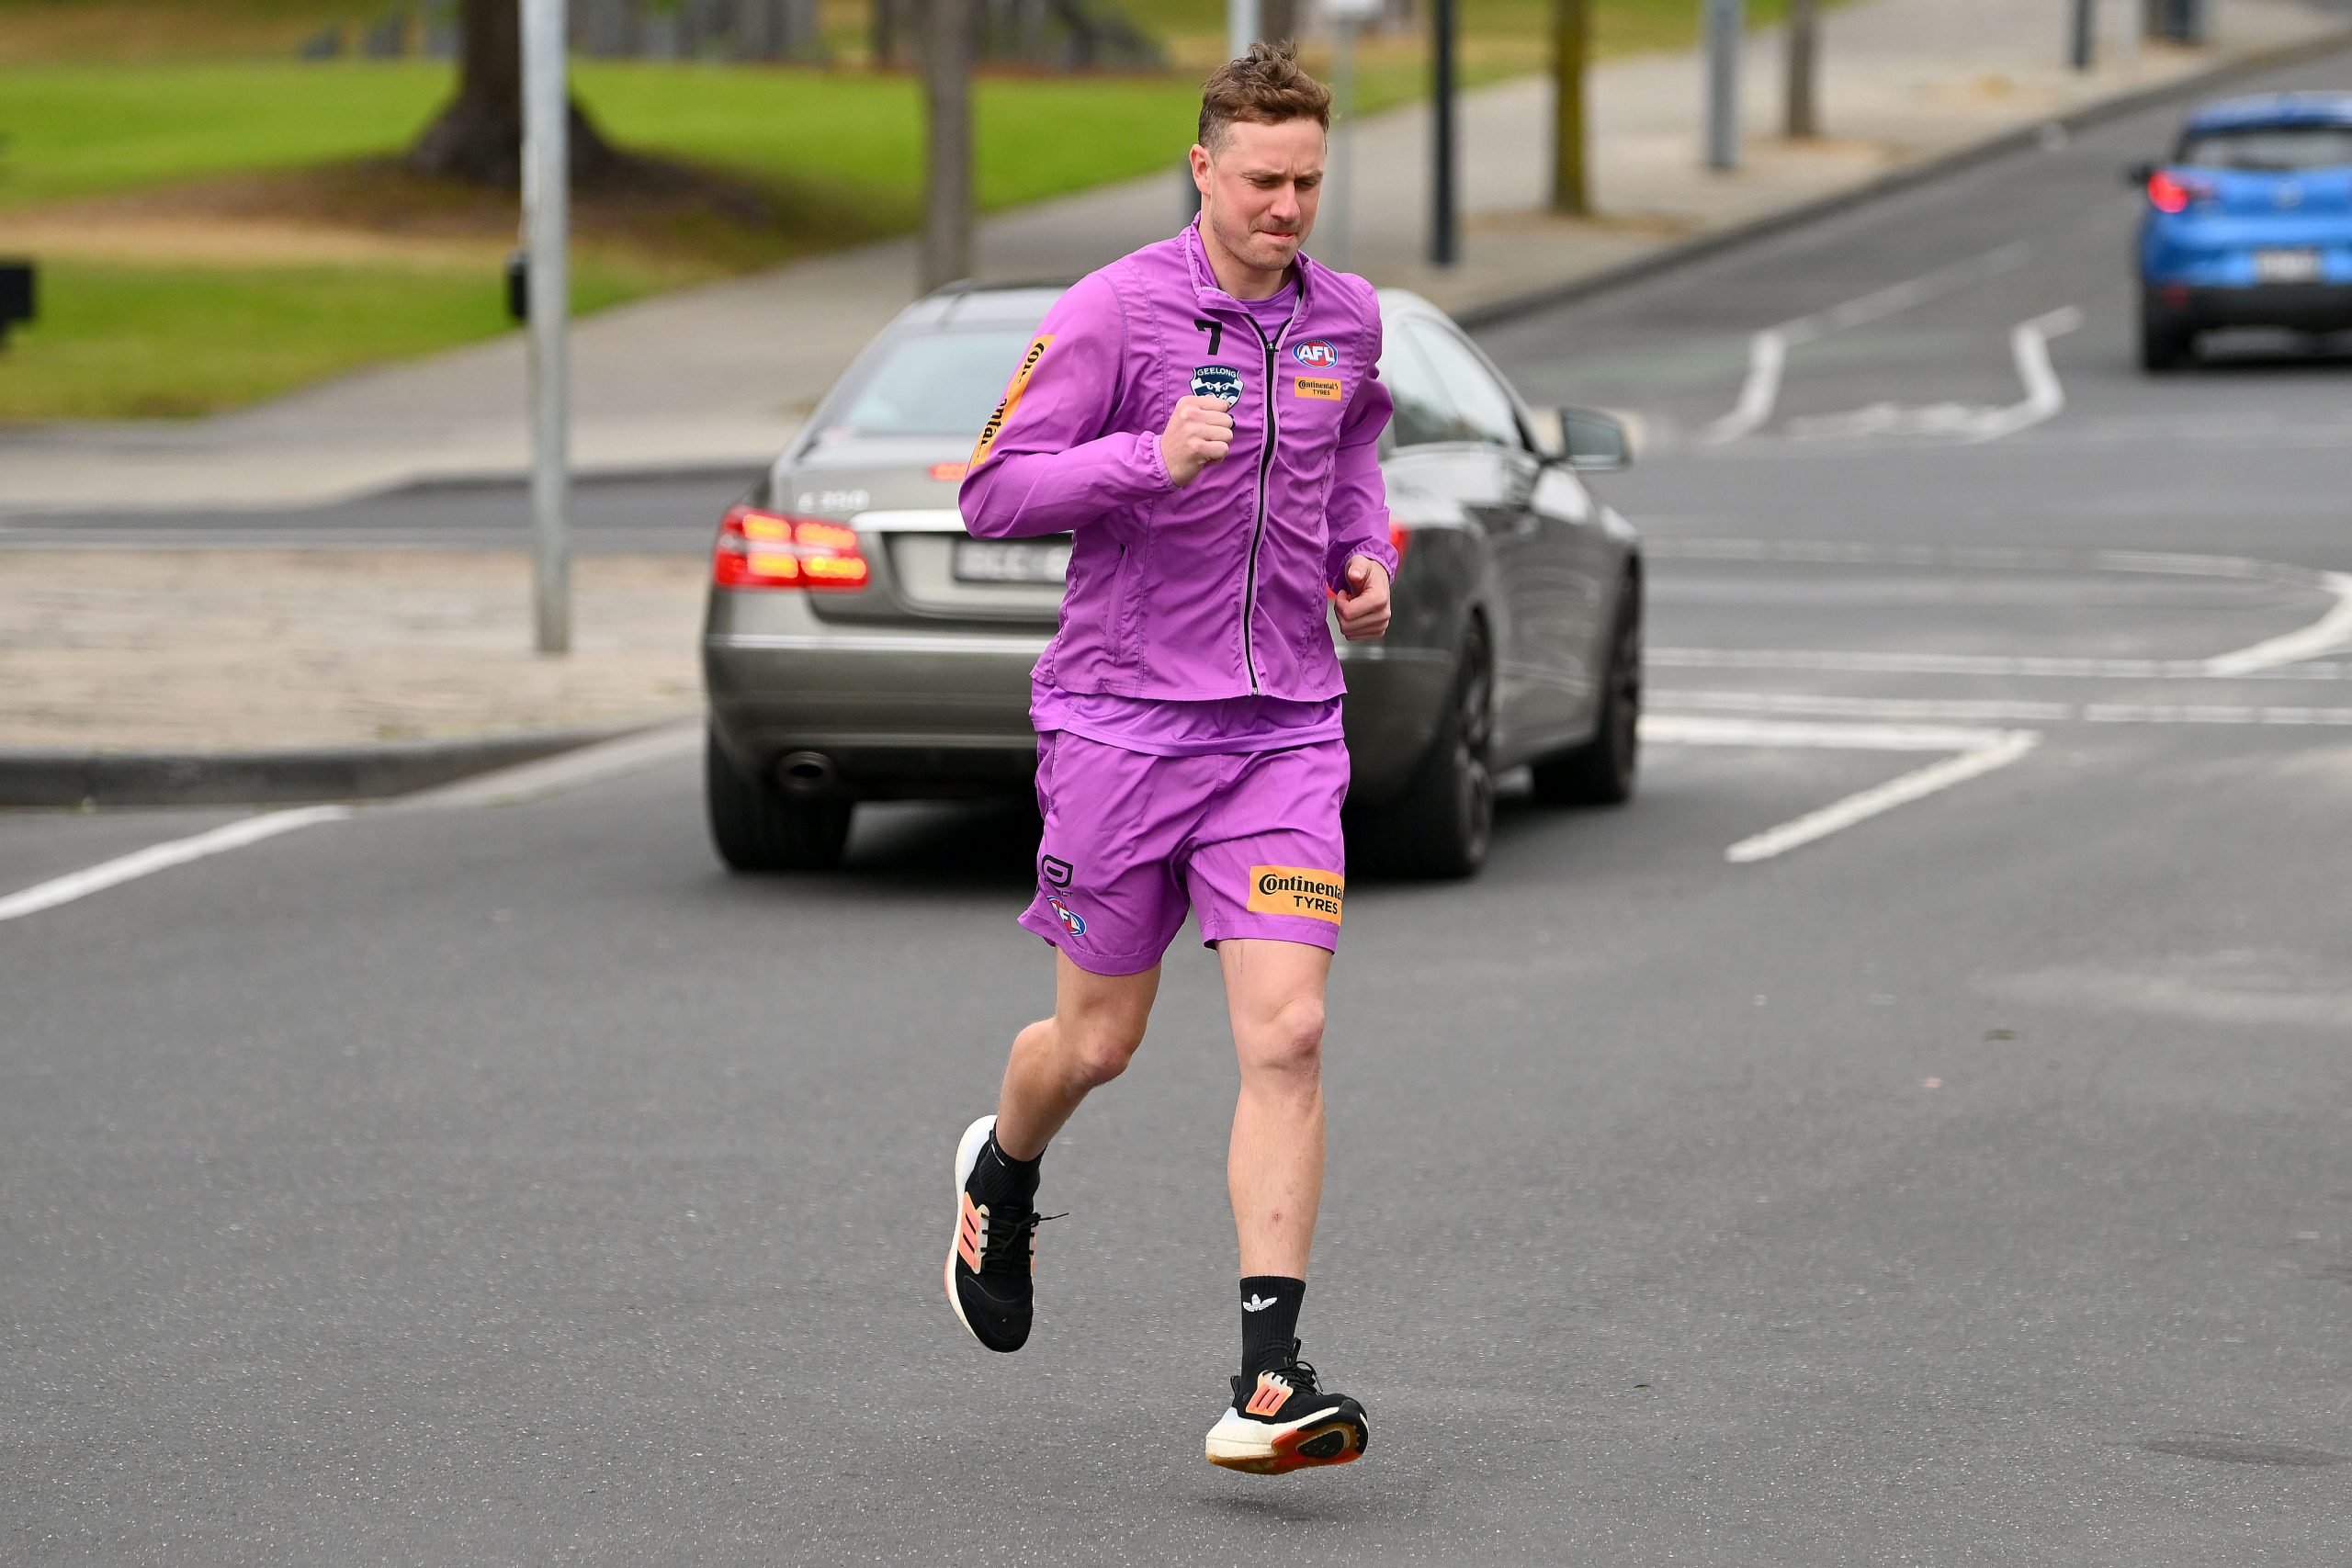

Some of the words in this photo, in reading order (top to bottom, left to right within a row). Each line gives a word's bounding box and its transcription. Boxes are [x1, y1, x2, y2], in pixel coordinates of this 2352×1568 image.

[1193, 319, 1223, 355] 7
[1298, 344, 1336, 364] AFL
[1196, 367, 1237, 378] GEELONG
[1293, 896, 1338, 915] TYRES
